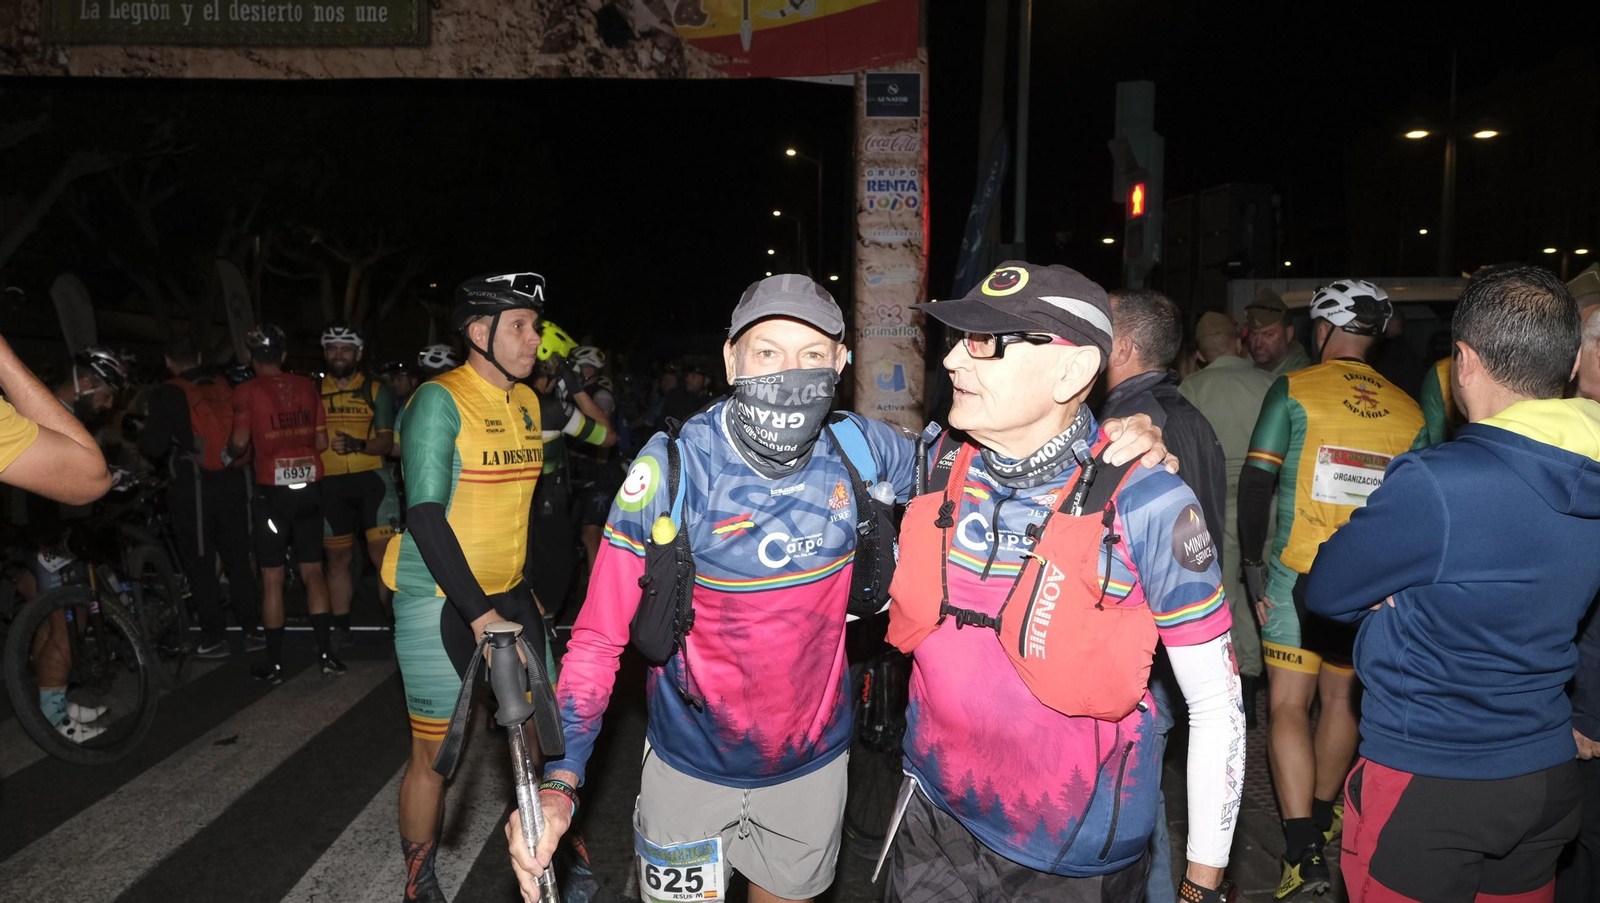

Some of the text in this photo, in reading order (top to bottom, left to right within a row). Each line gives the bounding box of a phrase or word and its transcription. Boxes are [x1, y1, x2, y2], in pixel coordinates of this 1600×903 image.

[79, 0, 388, 26] La Legión y el desierto nos une
[866, 169, 917, 177] GRUPO
[866, 180, 918, 192] RENTA
[866, 194, 919, 211] TODO
[864, 326, 919, 339] primaflor
[1342, 399, 1390, 419] ESPAÑOLA
[482, 451, 501, 465] LA
[283, 466, 311, 479] 6937
[1333, 471, 1383, 487] ORGANIZACIÓN
[957, 512, 1034, 550] Carpo
[758, 532, 823, 568] Carpo
[1029, 563, 1065, 660] AONIJIE
[1265, 644, 1303, 664] ÉRTICA
[638, 857, 704, 894] 625
